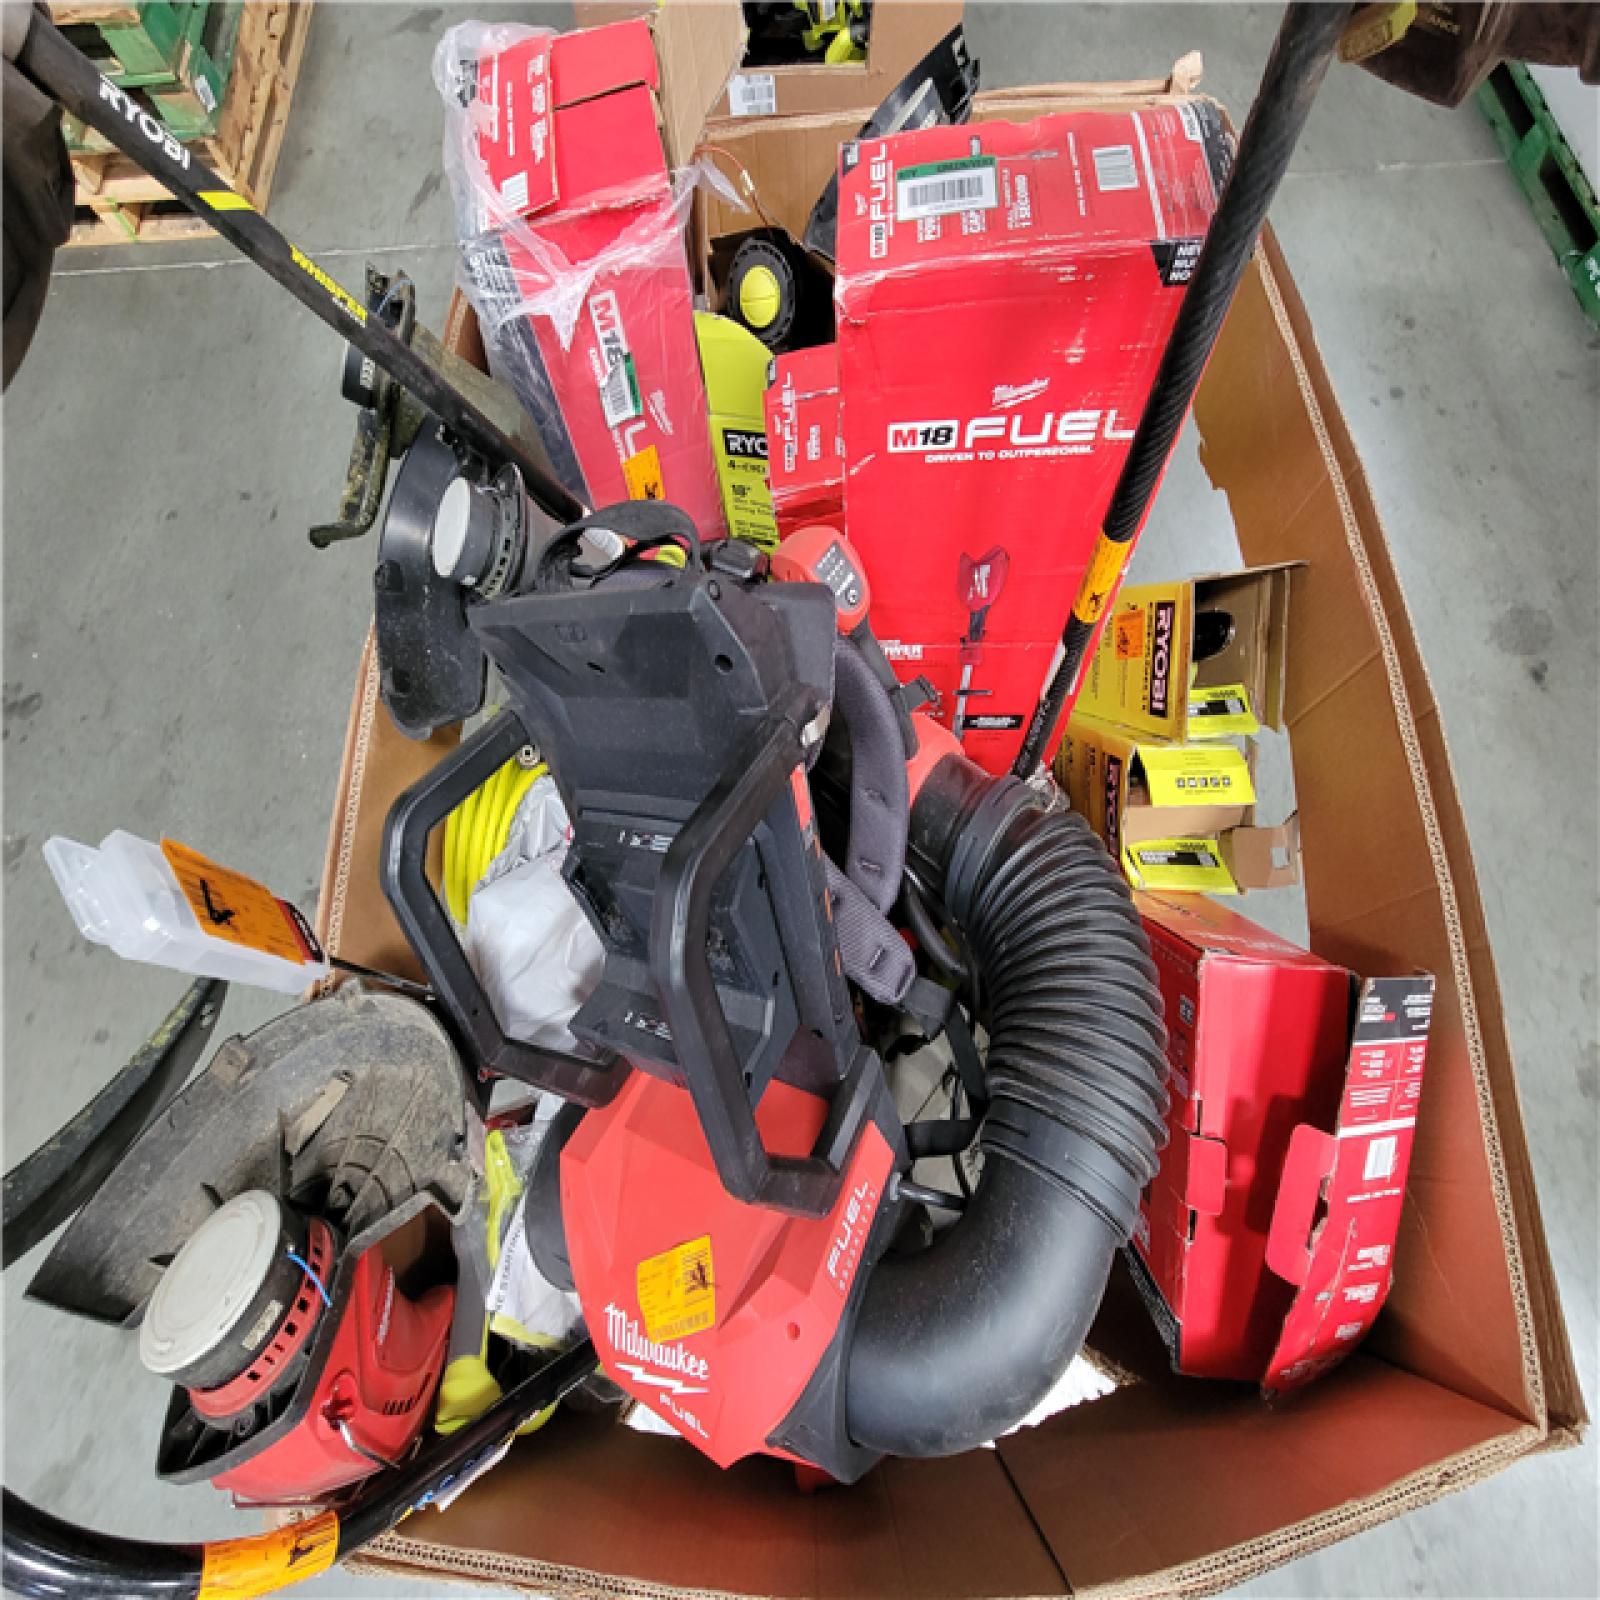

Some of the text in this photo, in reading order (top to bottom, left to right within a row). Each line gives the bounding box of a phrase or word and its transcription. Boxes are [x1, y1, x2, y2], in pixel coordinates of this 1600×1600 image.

[99, 75, 190, 170] RYOBI
[870, 142, 887, 221] FUEL
[891, 409, 1136, 449] M18 FUEL
[925, 454, 973, 463] DRIVEN
[978, 452, 996, 461] TO
[1153, 606, 1172, 711] RYOBI
[827, 1181, 868, 1278] FUEL
[604, 1301, 709, 1380] Milwaukee
